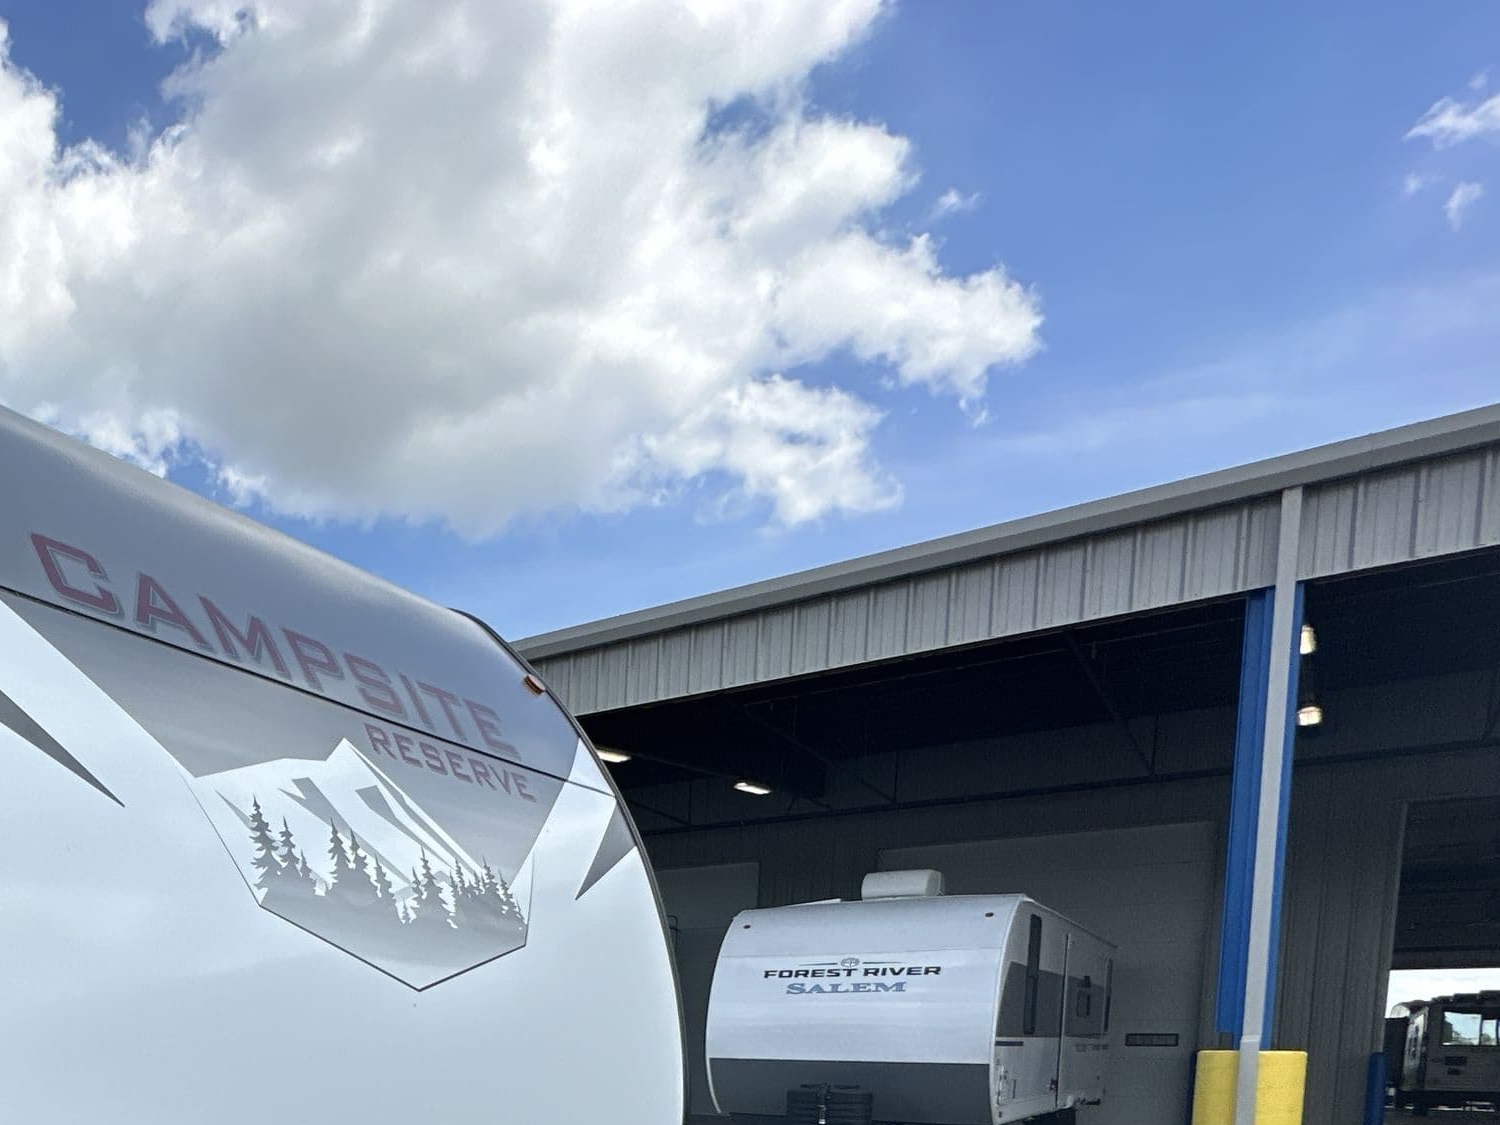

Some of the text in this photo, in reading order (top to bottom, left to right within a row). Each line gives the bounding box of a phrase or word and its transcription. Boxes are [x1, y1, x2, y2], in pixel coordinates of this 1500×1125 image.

[31, 533, 521, 761] CAMPSITE
[364, 724, 537, 802] RESERVE
[764, 966, 942, 979] FOREST RIVER
[786, 981, 907, 995] SALEM
